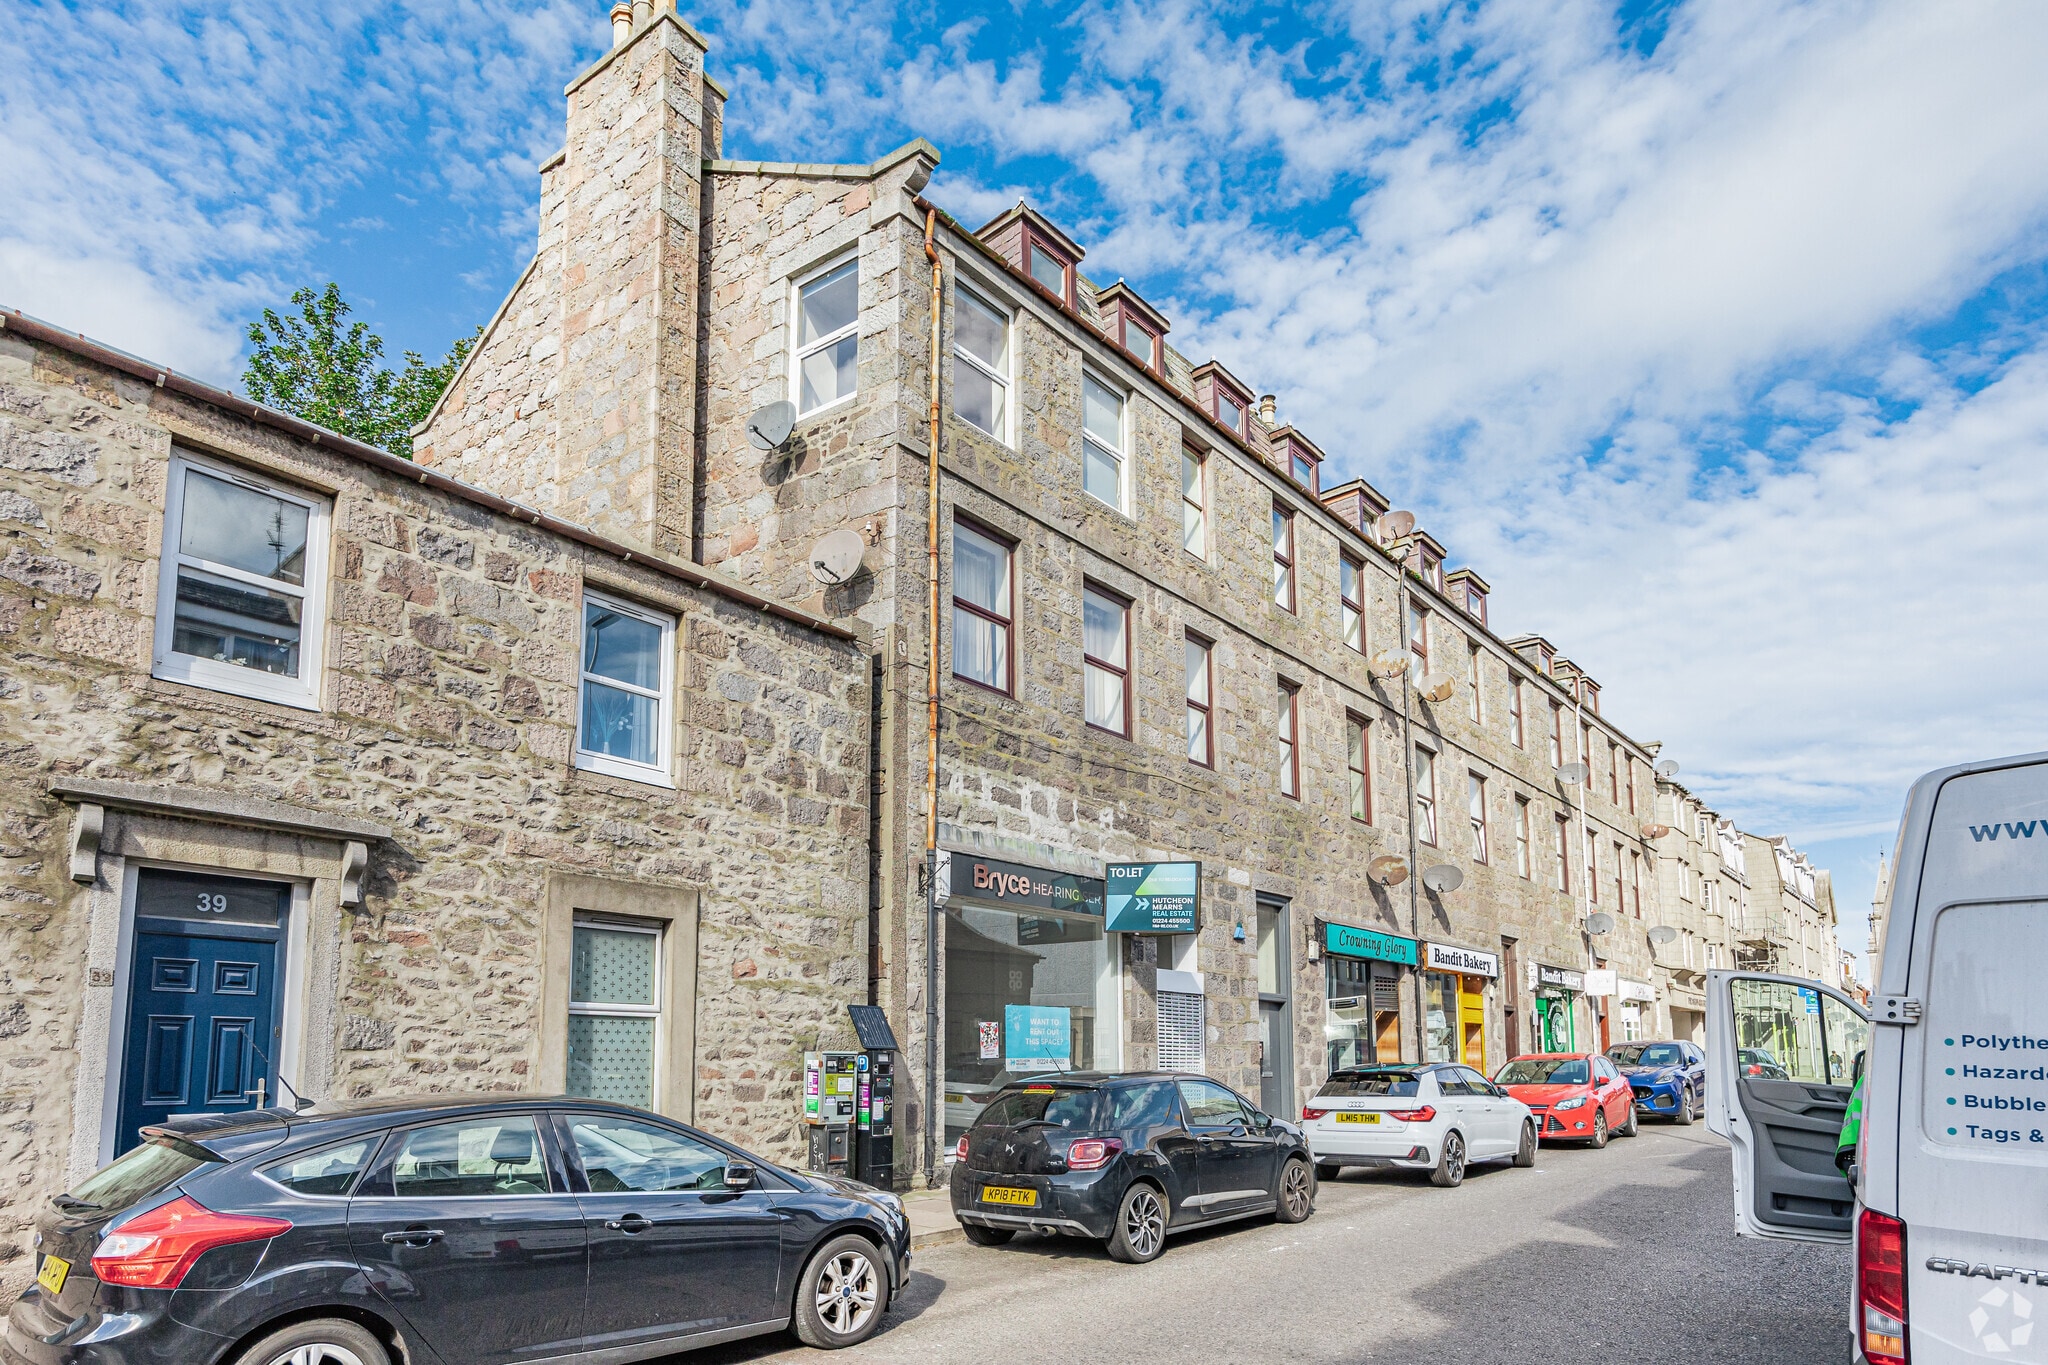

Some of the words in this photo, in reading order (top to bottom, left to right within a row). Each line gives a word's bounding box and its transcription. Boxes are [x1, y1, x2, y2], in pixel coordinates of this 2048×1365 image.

[1968, 819, 2048, 842] ww
[1110, 867, 1125, 878] TO
[1126, 867, 1144, 877] LET
[974, 863, 1031, 897] Bryce
[1033, 882, 1080, 901] HEARING
[196, 893, 227, 913] 39
[1339, 929, 1382, 957] Crowning
[1384, 937, 1407, 960] Glory
[1434, 947, 1462, 967] Bandit
[1463, 953, 1492, 975] Bakery
[92, 971, 112, 982] 39
[1541, 967, 1561, 984] Bandit
[1561, 971, 1582, 989] Bakery
[1051, 1018, 1060, 1026] TO
[1041, 1038, 1064, 1046] SPACE?
[1961, 1034, 2048, 1052] Polythe
[1963, 1064, 2048, 1081] Hazard
[1964, 1094, 2047, 1112] Bubble
[1340, 1113, 1358, 1122] LM15
[1360, 1113, 1376, 1123] THM
[1965, 1124, 2021, 1143] Tags
[2029, 1128, 2044, 1143] &
[988, 1186, 1009, 1201] KP18
[1010, 1189, 1030, 1203] FTK
